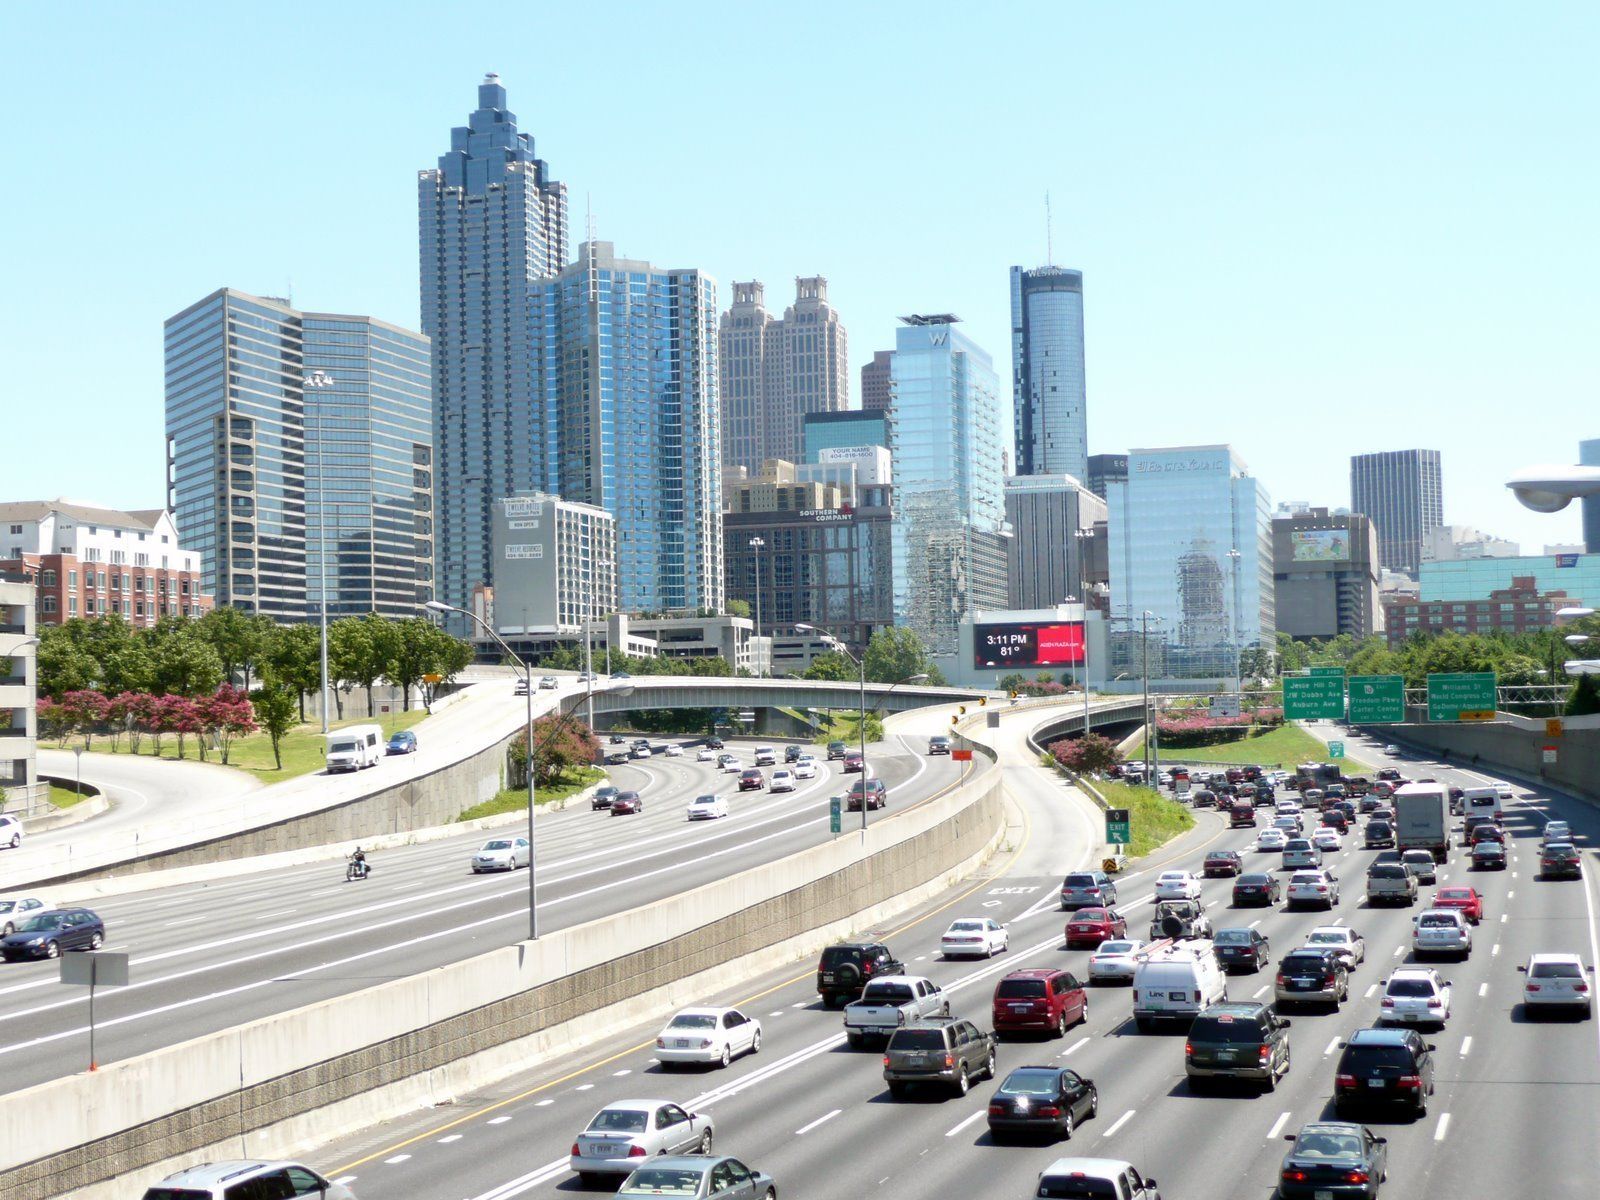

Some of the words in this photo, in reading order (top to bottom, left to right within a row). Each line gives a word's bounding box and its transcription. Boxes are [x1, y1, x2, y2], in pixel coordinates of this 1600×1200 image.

[928, 332, 948, 346] W
[800, 509, 838, 517] SOUTHERN
[816, 514, 853, 522] COMPANY
[987, 636, 1007, 645] 3:11
[1010, 635, 1027, 644] PM
[1450, 692, 1480, 700] Congress
[1109, 823, 1126, 831] EXIT
[988, 886, 1040, 895] EXIT
